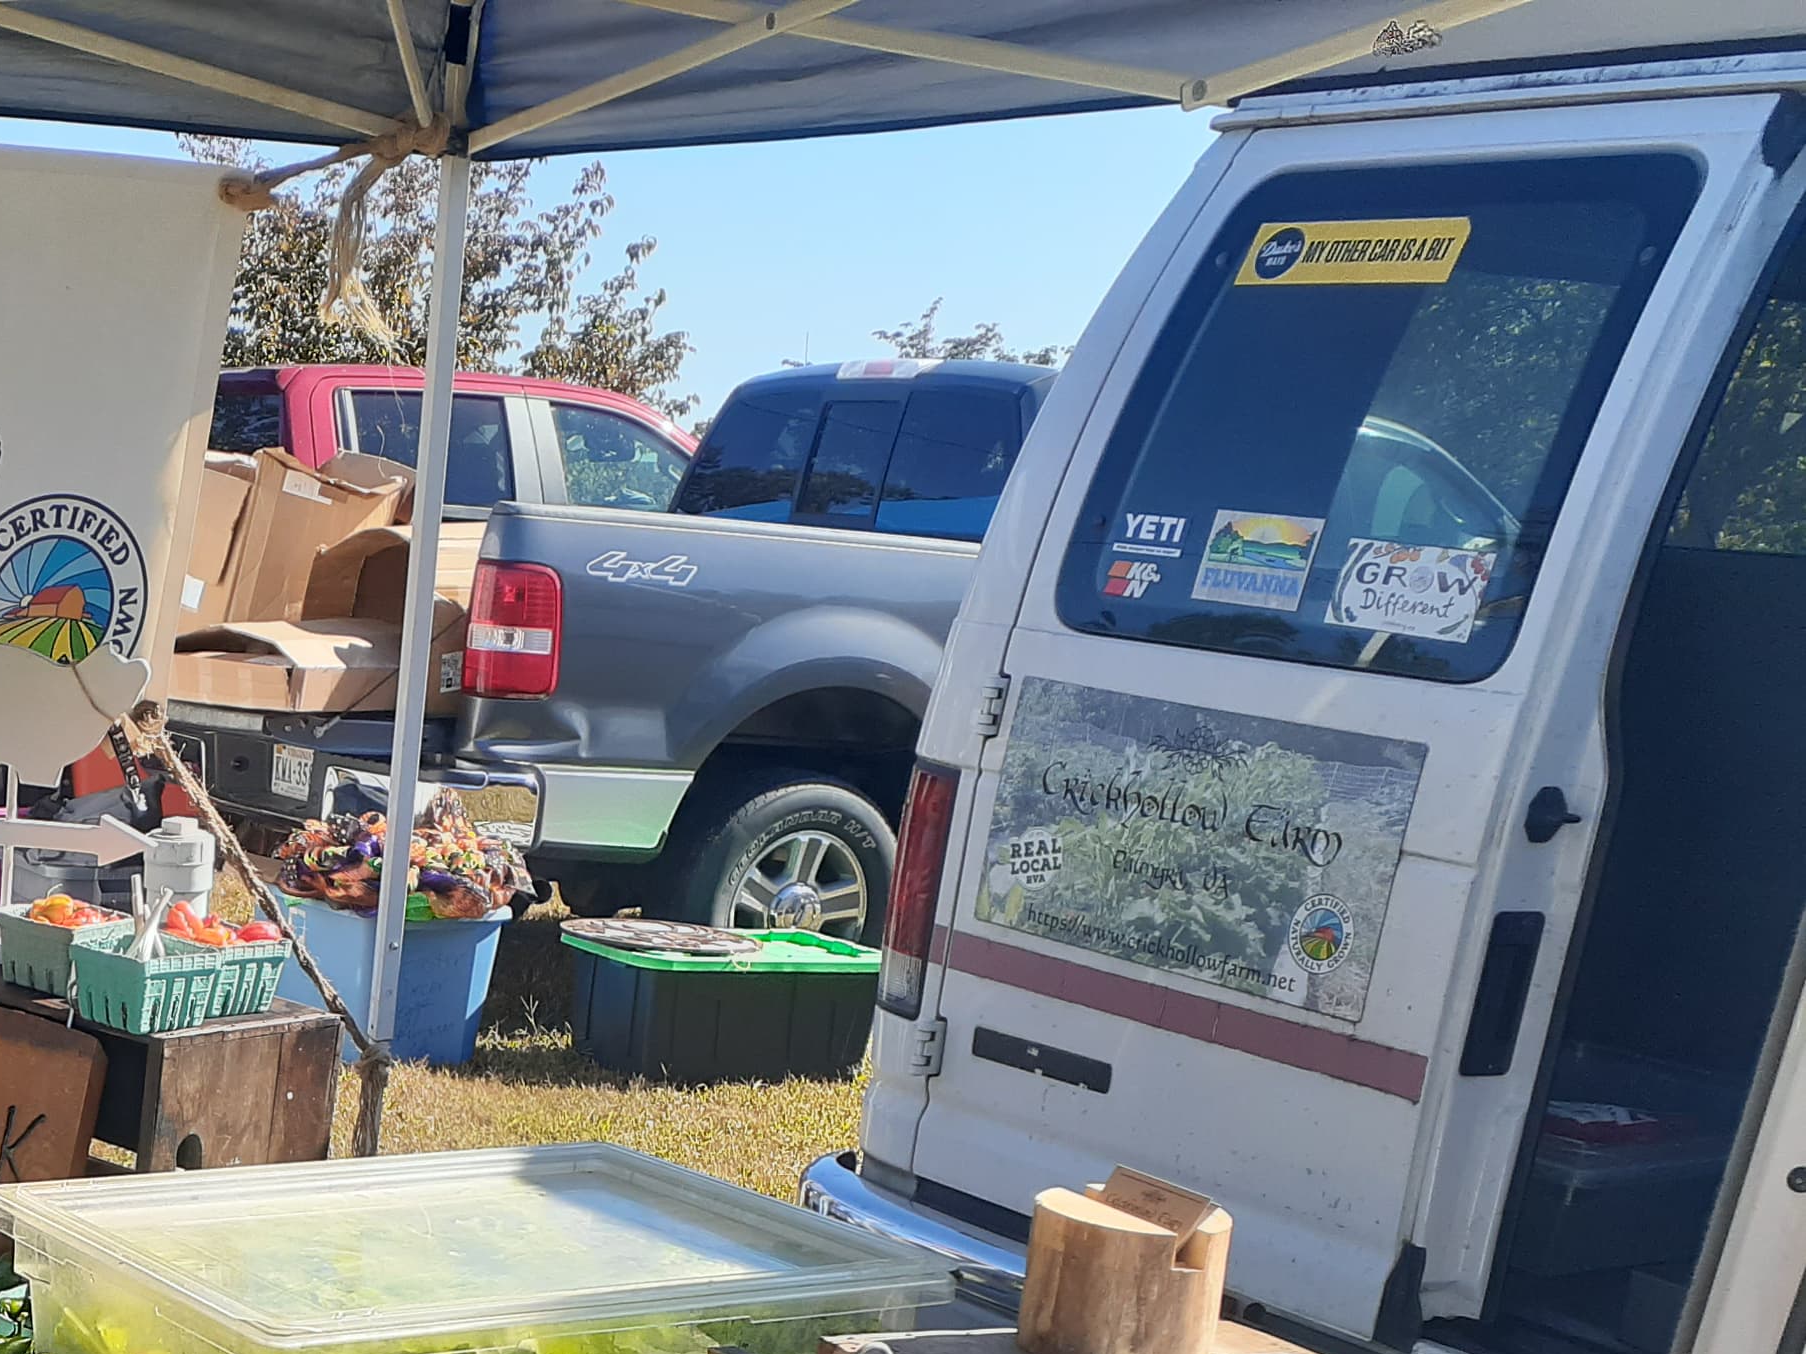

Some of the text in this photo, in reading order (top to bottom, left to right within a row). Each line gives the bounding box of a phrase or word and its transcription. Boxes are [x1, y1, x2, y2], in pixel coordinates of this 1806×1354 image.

[1302, 237, 1456, 263] MY OTHER CAR IS A BLT
[1125, 513, 1187, 542] YETI
[586, 550, 698, 586] 4x4
[1202, 567, 1300, 597] FLUVANNA
[1356, 562, 1479, 595] GROW
[1359, 587, 1455, 618] Different
[1042, 761, 1227, 829] Crickhollow
[1010, 838, 1061, 858] REAL
[1010, 857, 1061, 875] LOCAL
[1304, 897, 1350, 924] CERTIFIED
[1027, 902, 1296, 992] https://www.crickhollowfarm.net
[1291, 919, 1322, 971] NATURALLY
[1327, 932, 1352, 968] GROWN
